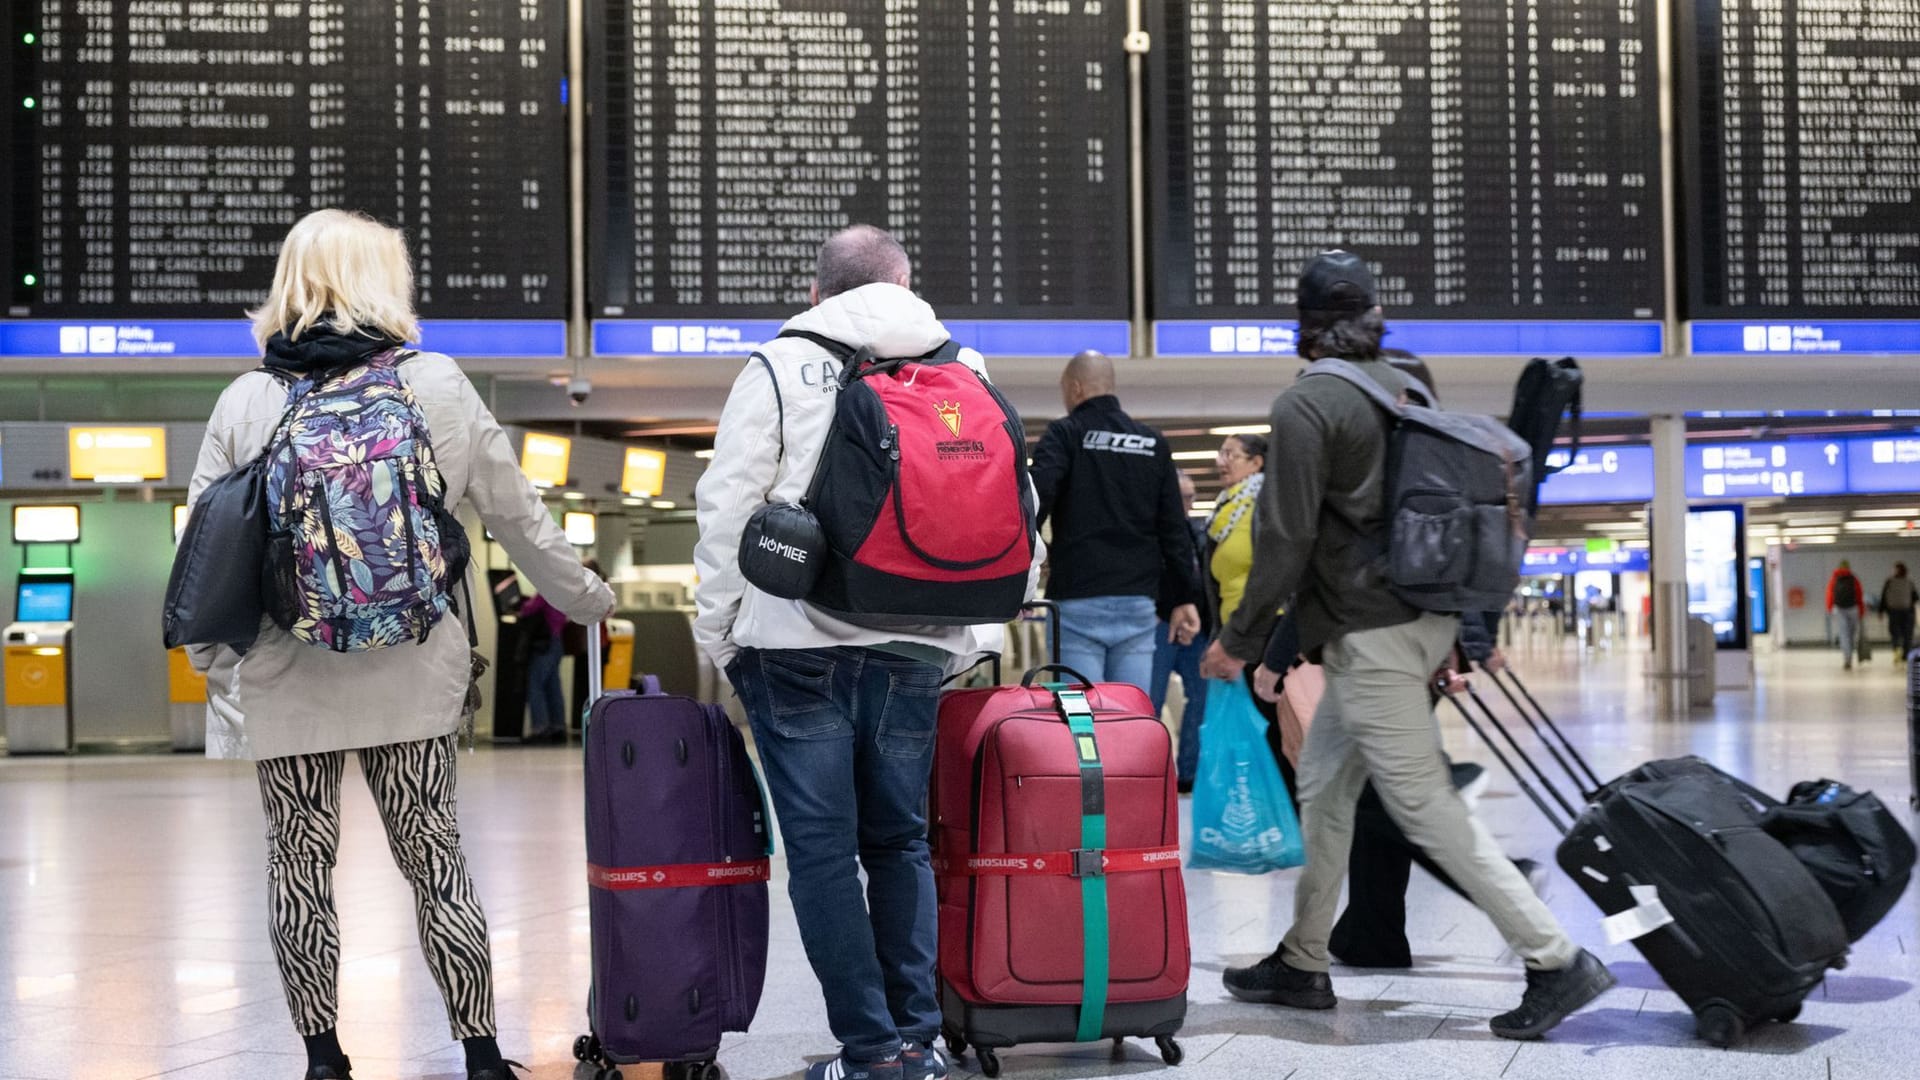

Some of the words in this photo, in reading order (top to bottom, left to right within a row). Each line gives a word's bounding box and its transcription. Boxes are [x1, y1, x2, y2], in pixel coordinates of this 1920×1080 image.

[801, 361, 839, 386] CA
[758, 535, 808, 564] HOMIEE
[706, 865, 755, 879] Samsonite
